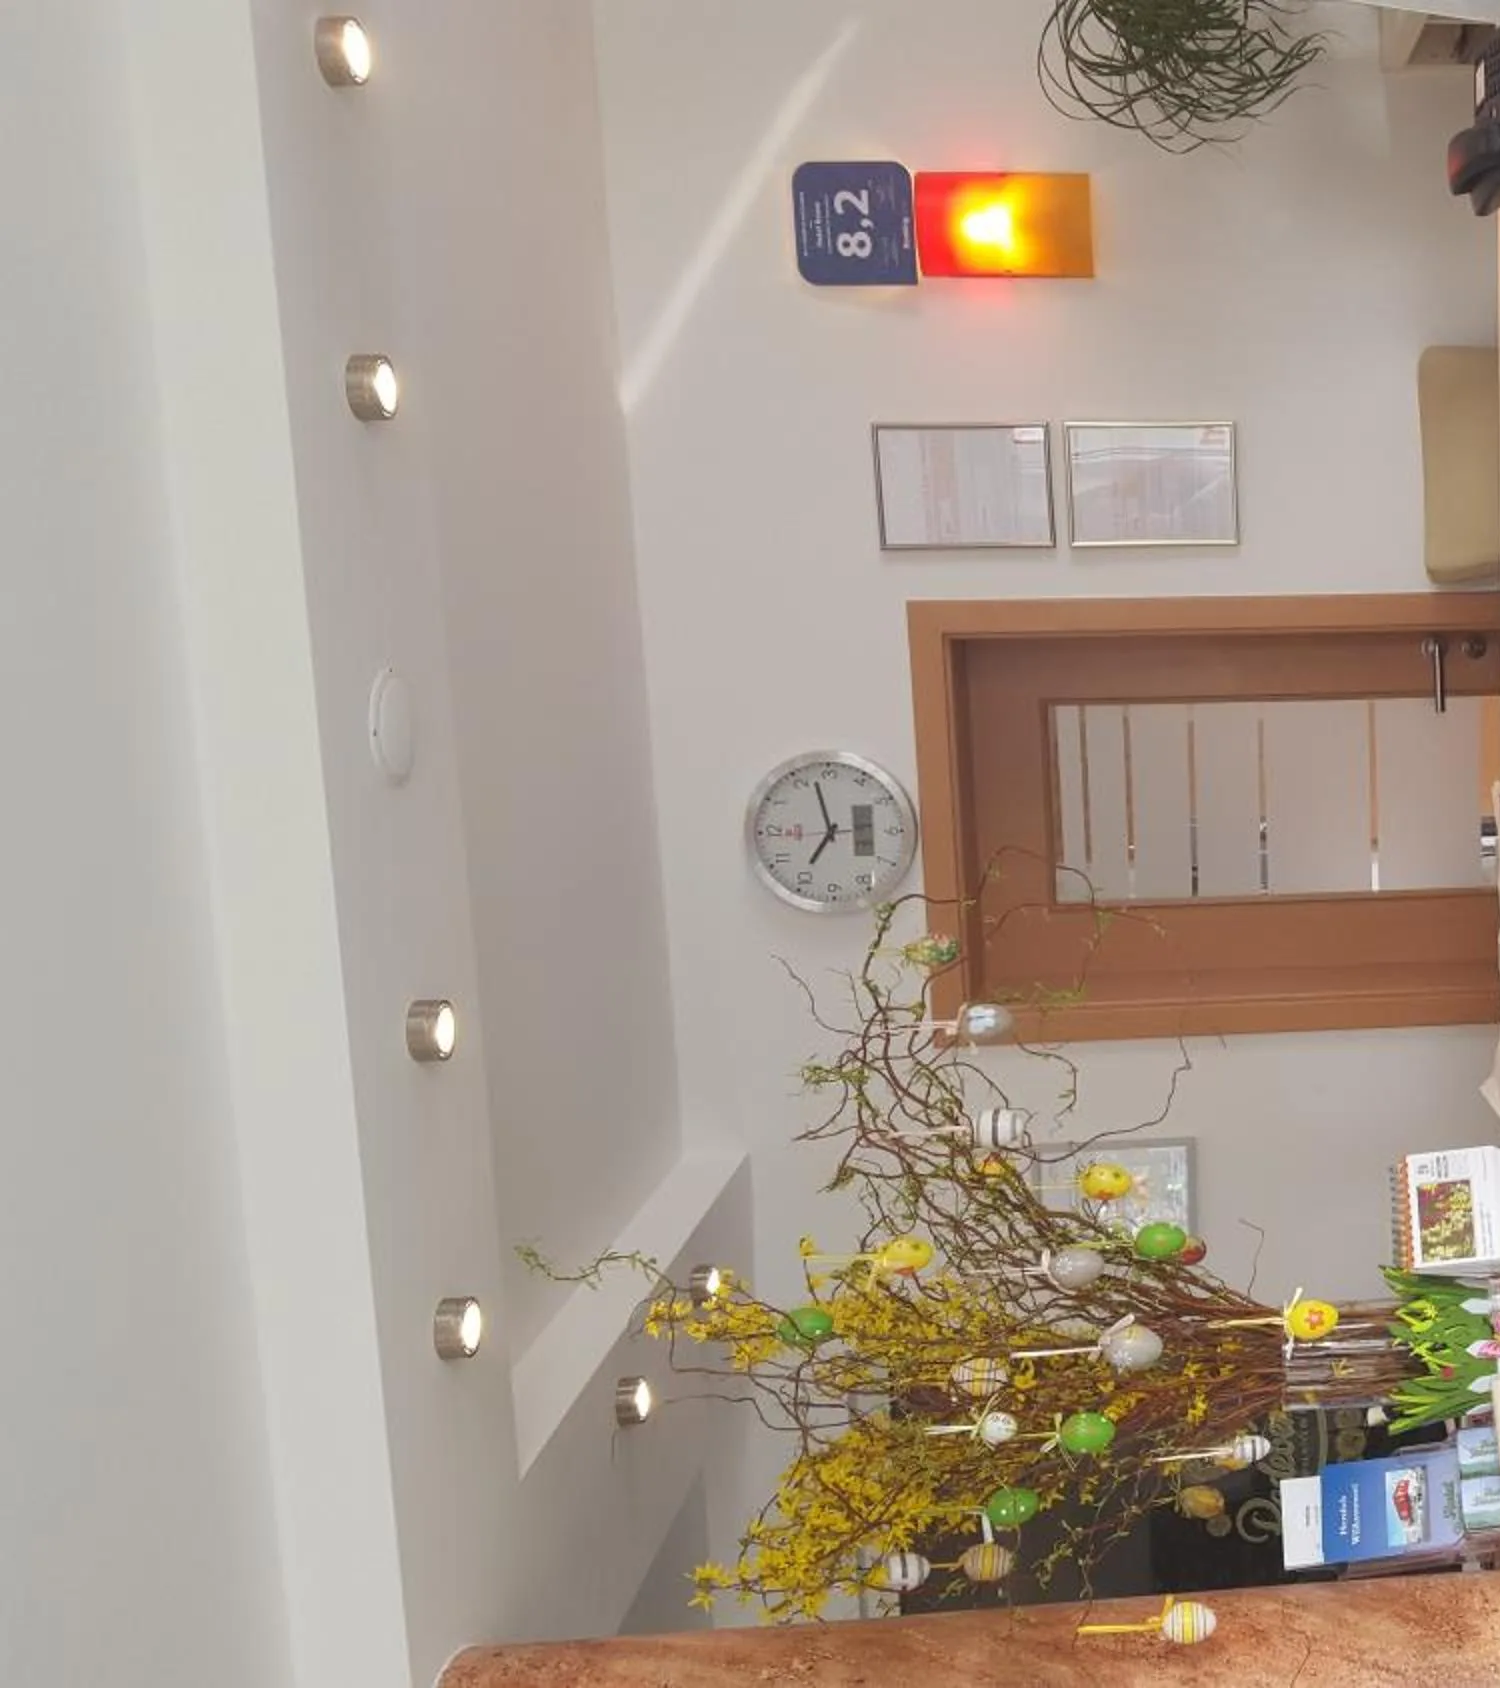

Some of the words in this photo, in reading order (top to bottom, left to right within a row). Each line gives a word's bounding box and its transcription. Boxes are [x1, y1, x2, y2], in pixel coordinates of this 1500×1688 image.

[834, 189, 873, 258] 8,2
[822, 769, 837, 780] 3
[794, 780, 809, 789] 2
[854, 777, 866, 787] 4
[767, 824, 782, 837] 12
[884, 825, 899, 835] 6
[775, 852, 791, 864] 11
[798, 871, 813, 885] 10
[855, 873, 871, 885] 8
[827, 883, 842, 893] 9
